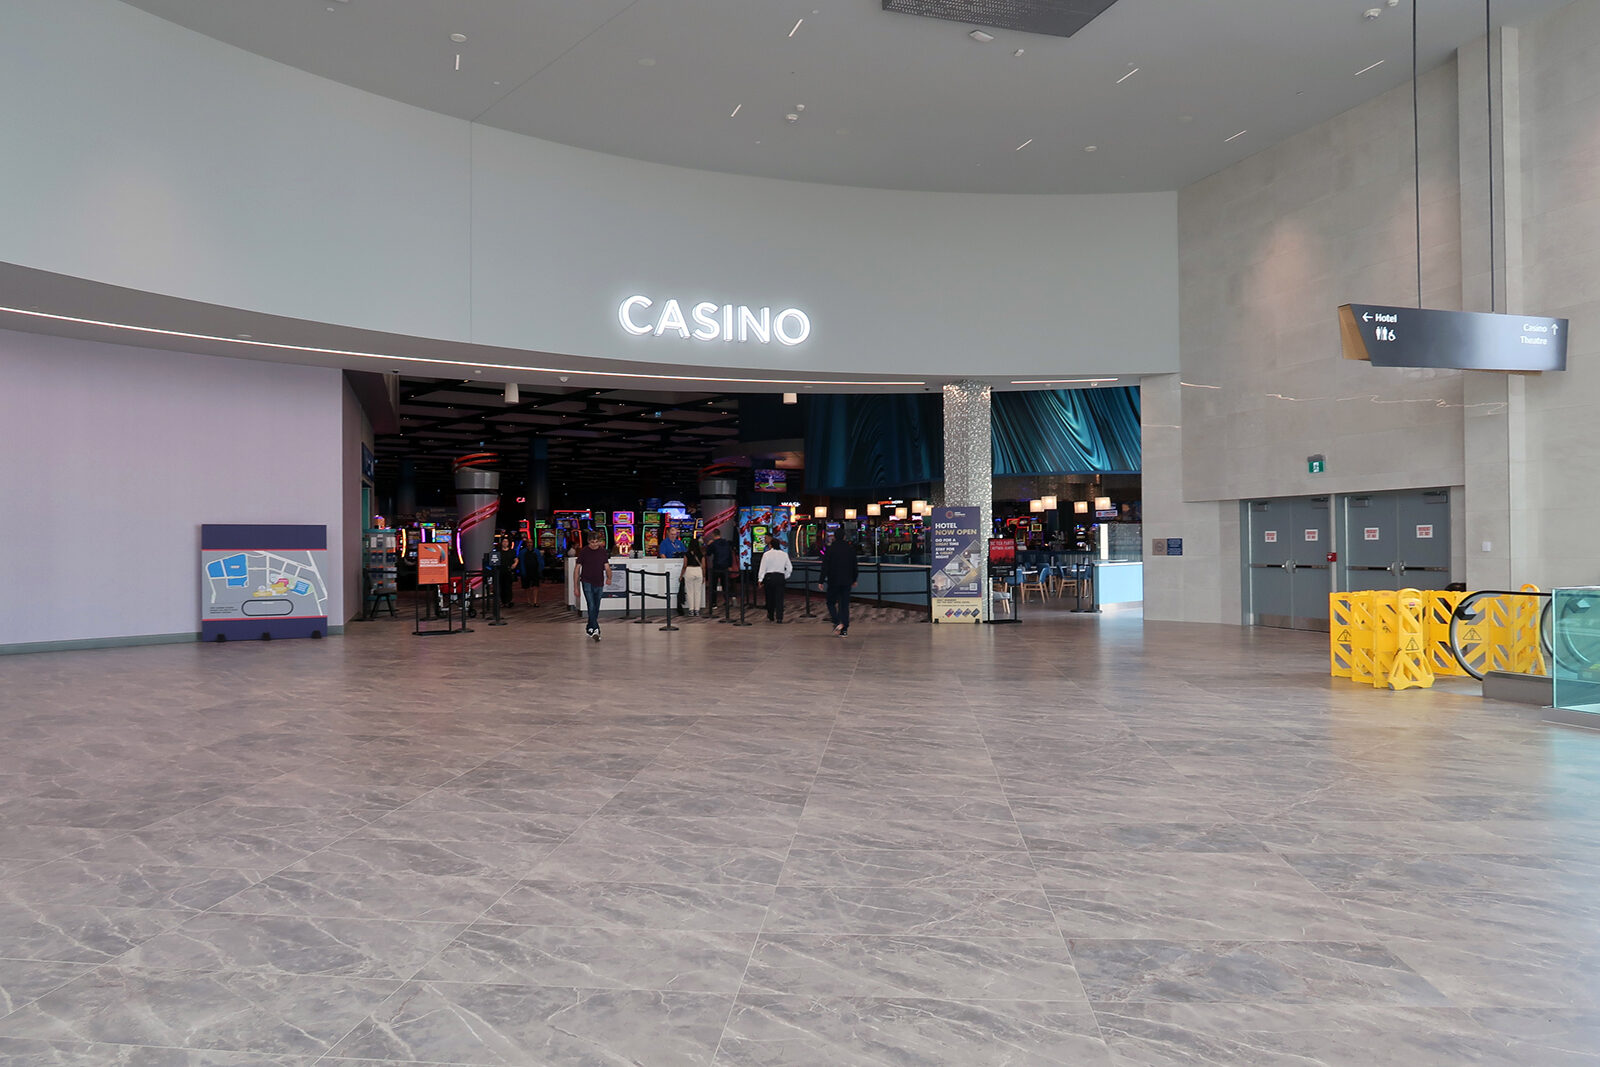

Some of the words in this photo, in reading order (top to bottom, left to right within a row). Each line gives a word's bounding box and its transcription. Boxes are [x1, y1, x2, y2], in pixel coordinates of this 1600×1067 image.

[618, 295, 811, 345] CASINO
[1375, 313, 1397, 323] Hotel
[1523, 323, 1548, 333] Casino
[1388, 329, 1396, 341] 6
[1520, 336, 1548, 345] Theatre
